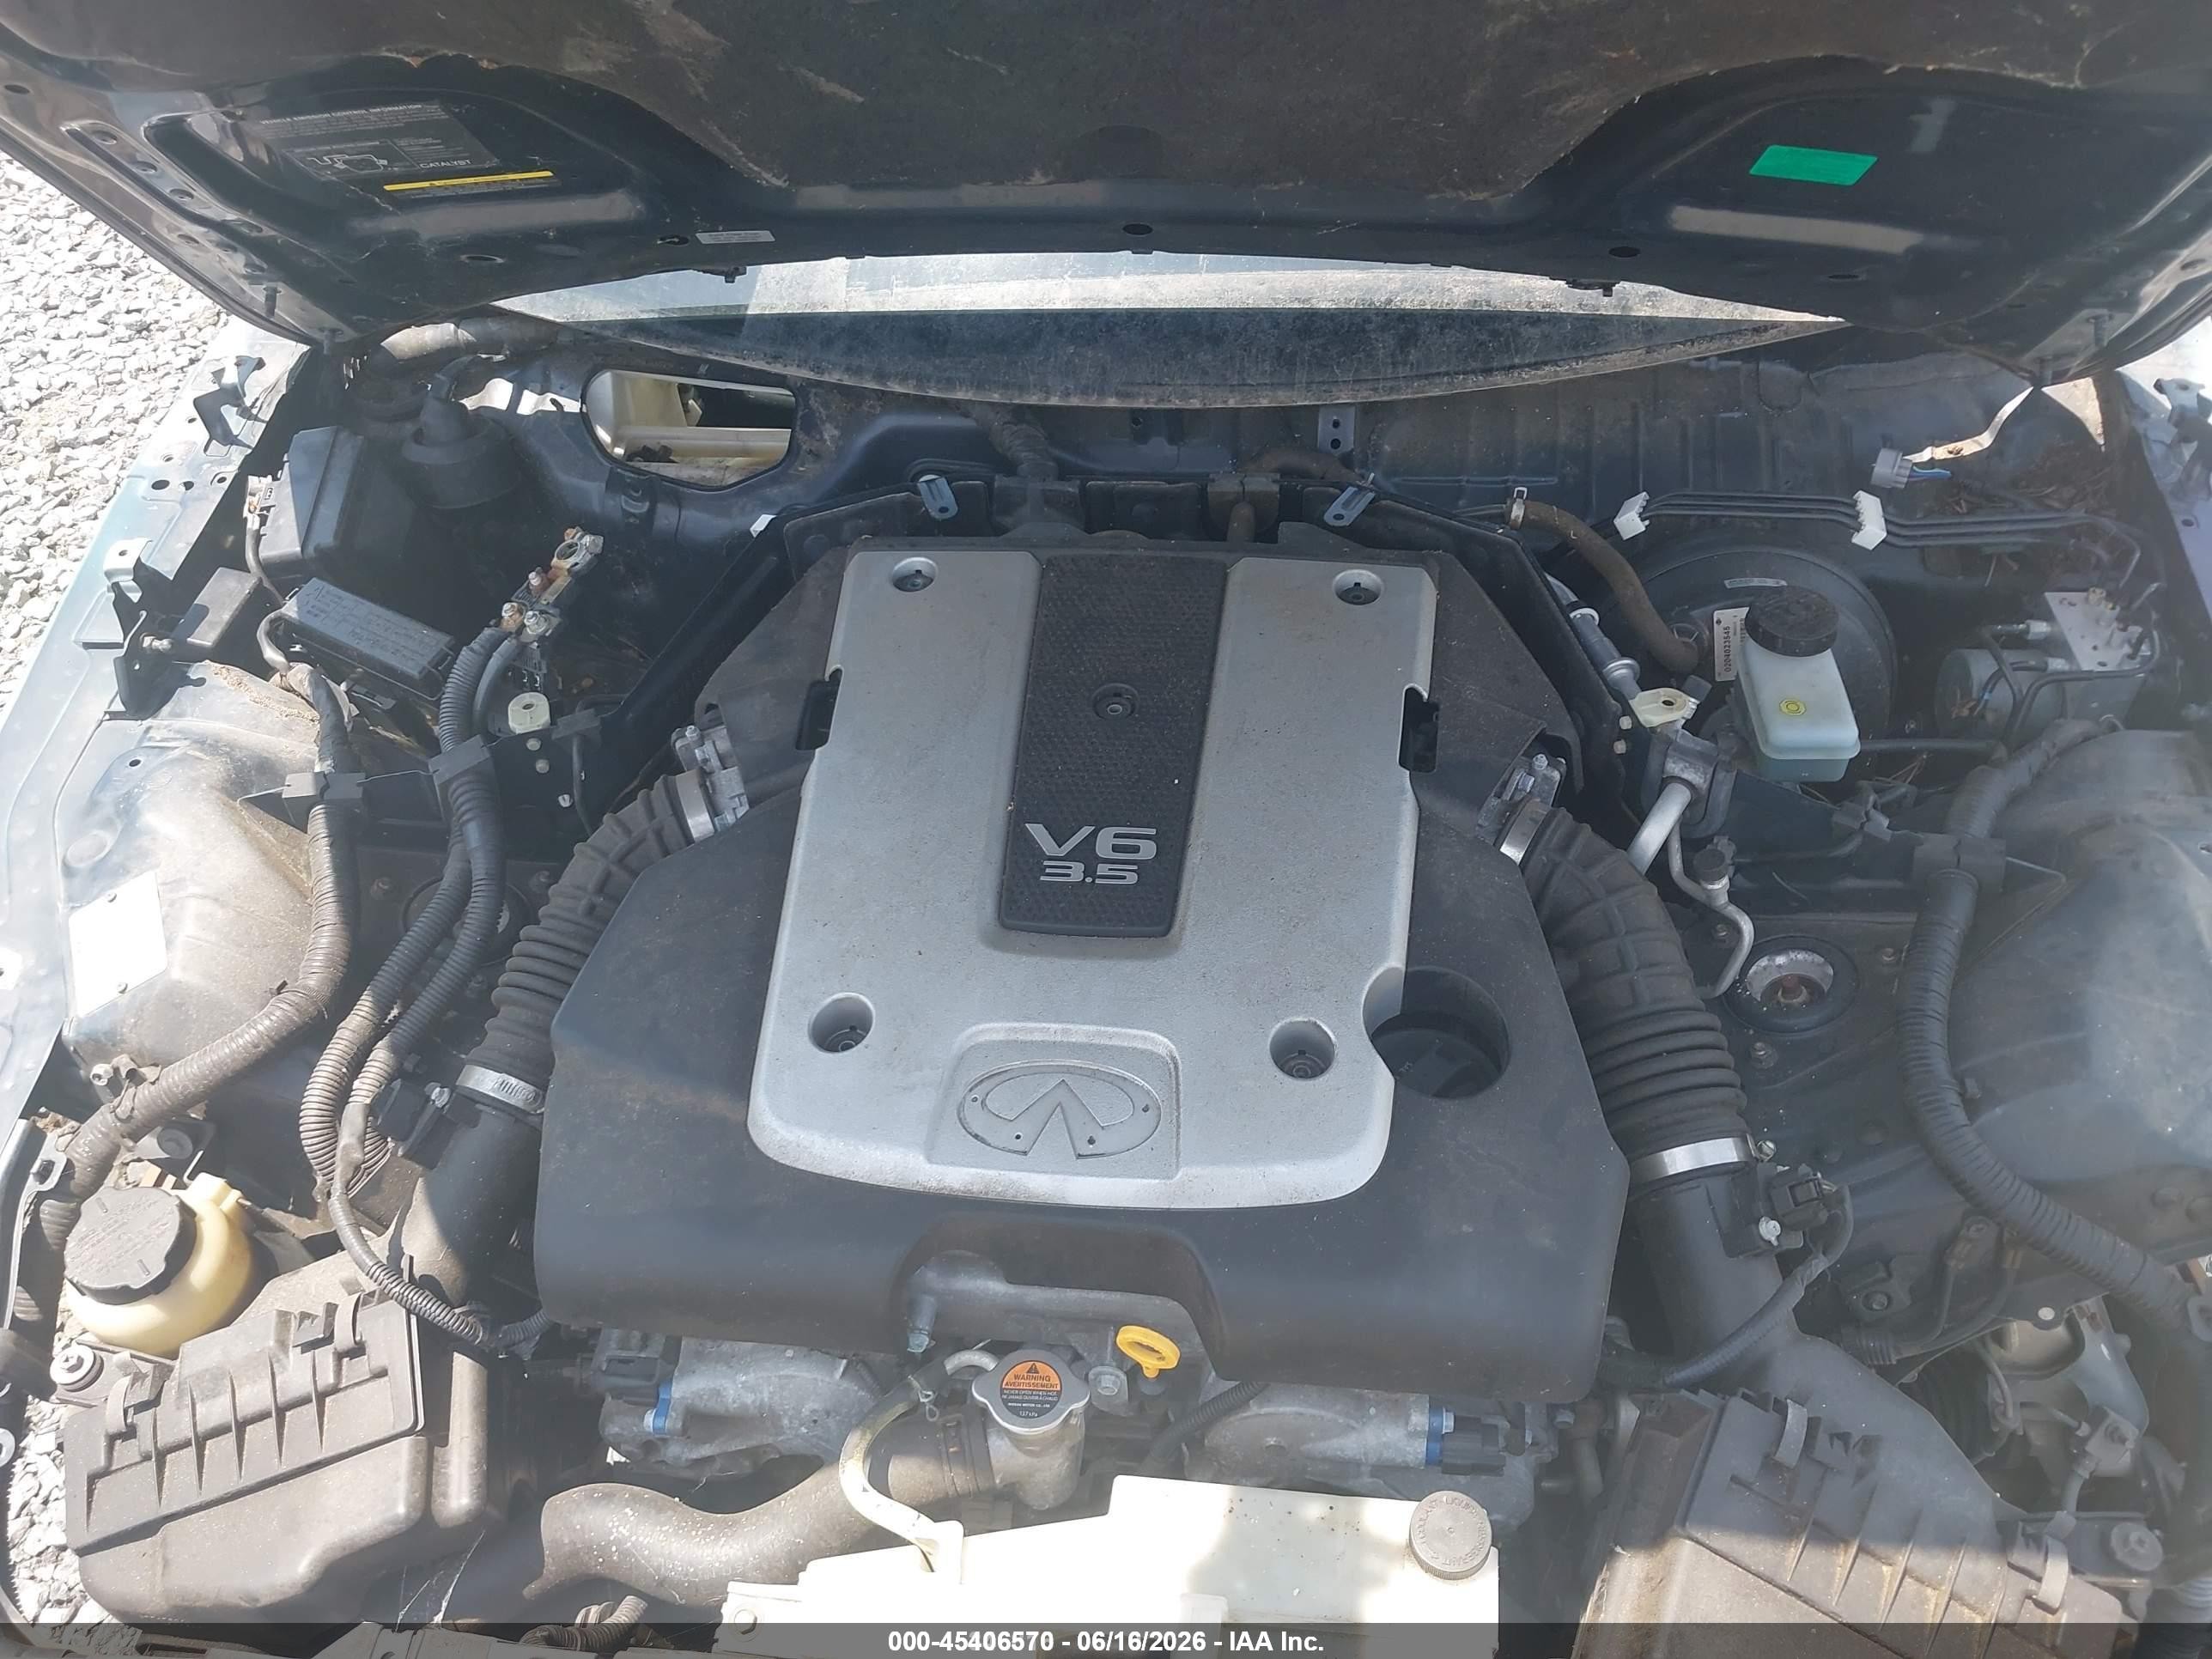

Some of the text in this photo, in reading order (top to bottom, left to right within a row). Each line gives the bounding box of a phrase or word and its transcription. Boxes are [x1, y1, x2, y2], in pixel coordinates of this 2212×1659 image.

[420, 159, 472, 169] CATALYST
[1024, 823, 1157, 860] V6
[1040, 860, 1138, 884] 3.5
[1013, 1374, 1051, 1382] WARNING
[1004, 1381, 1058, 1389] AVERTISSEMENT
